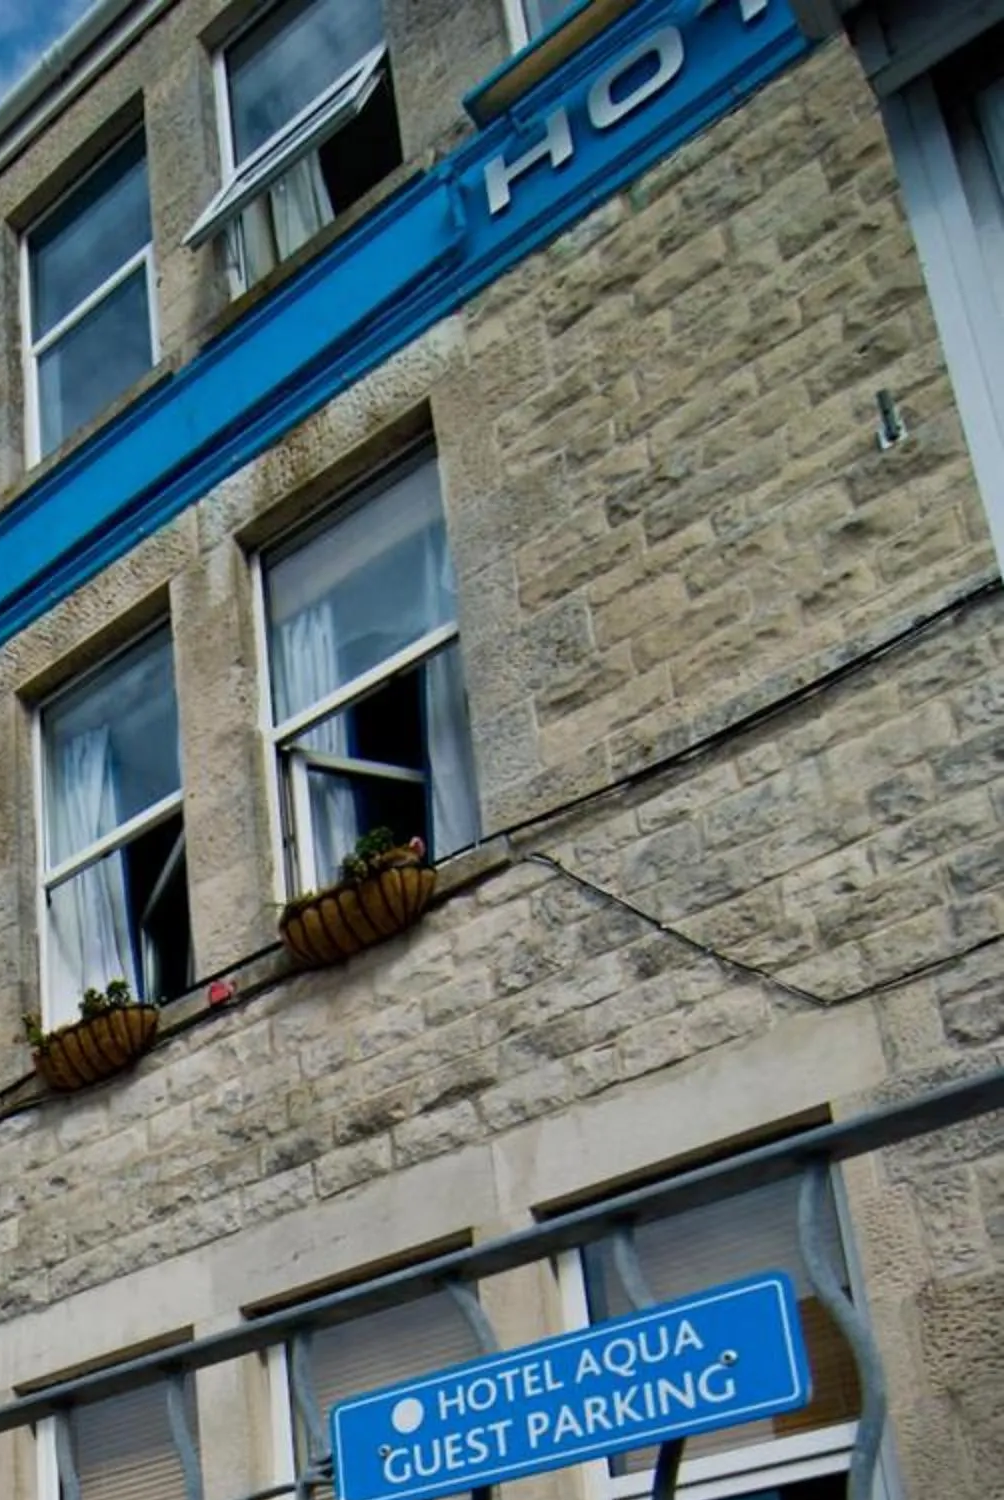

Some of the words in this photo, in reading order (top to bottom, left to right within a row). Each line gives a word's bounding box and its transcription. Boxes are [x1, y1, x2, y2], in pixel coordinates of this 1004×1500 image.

[484, 0, 769, 215] HO
[383, 1420, 512, 1484] GUEST
[528, 1362, 737, 1449] PARKING
[438, 1360, 564, 1421] HOTEL
[575, 1320, 704, 1384] AQUA
